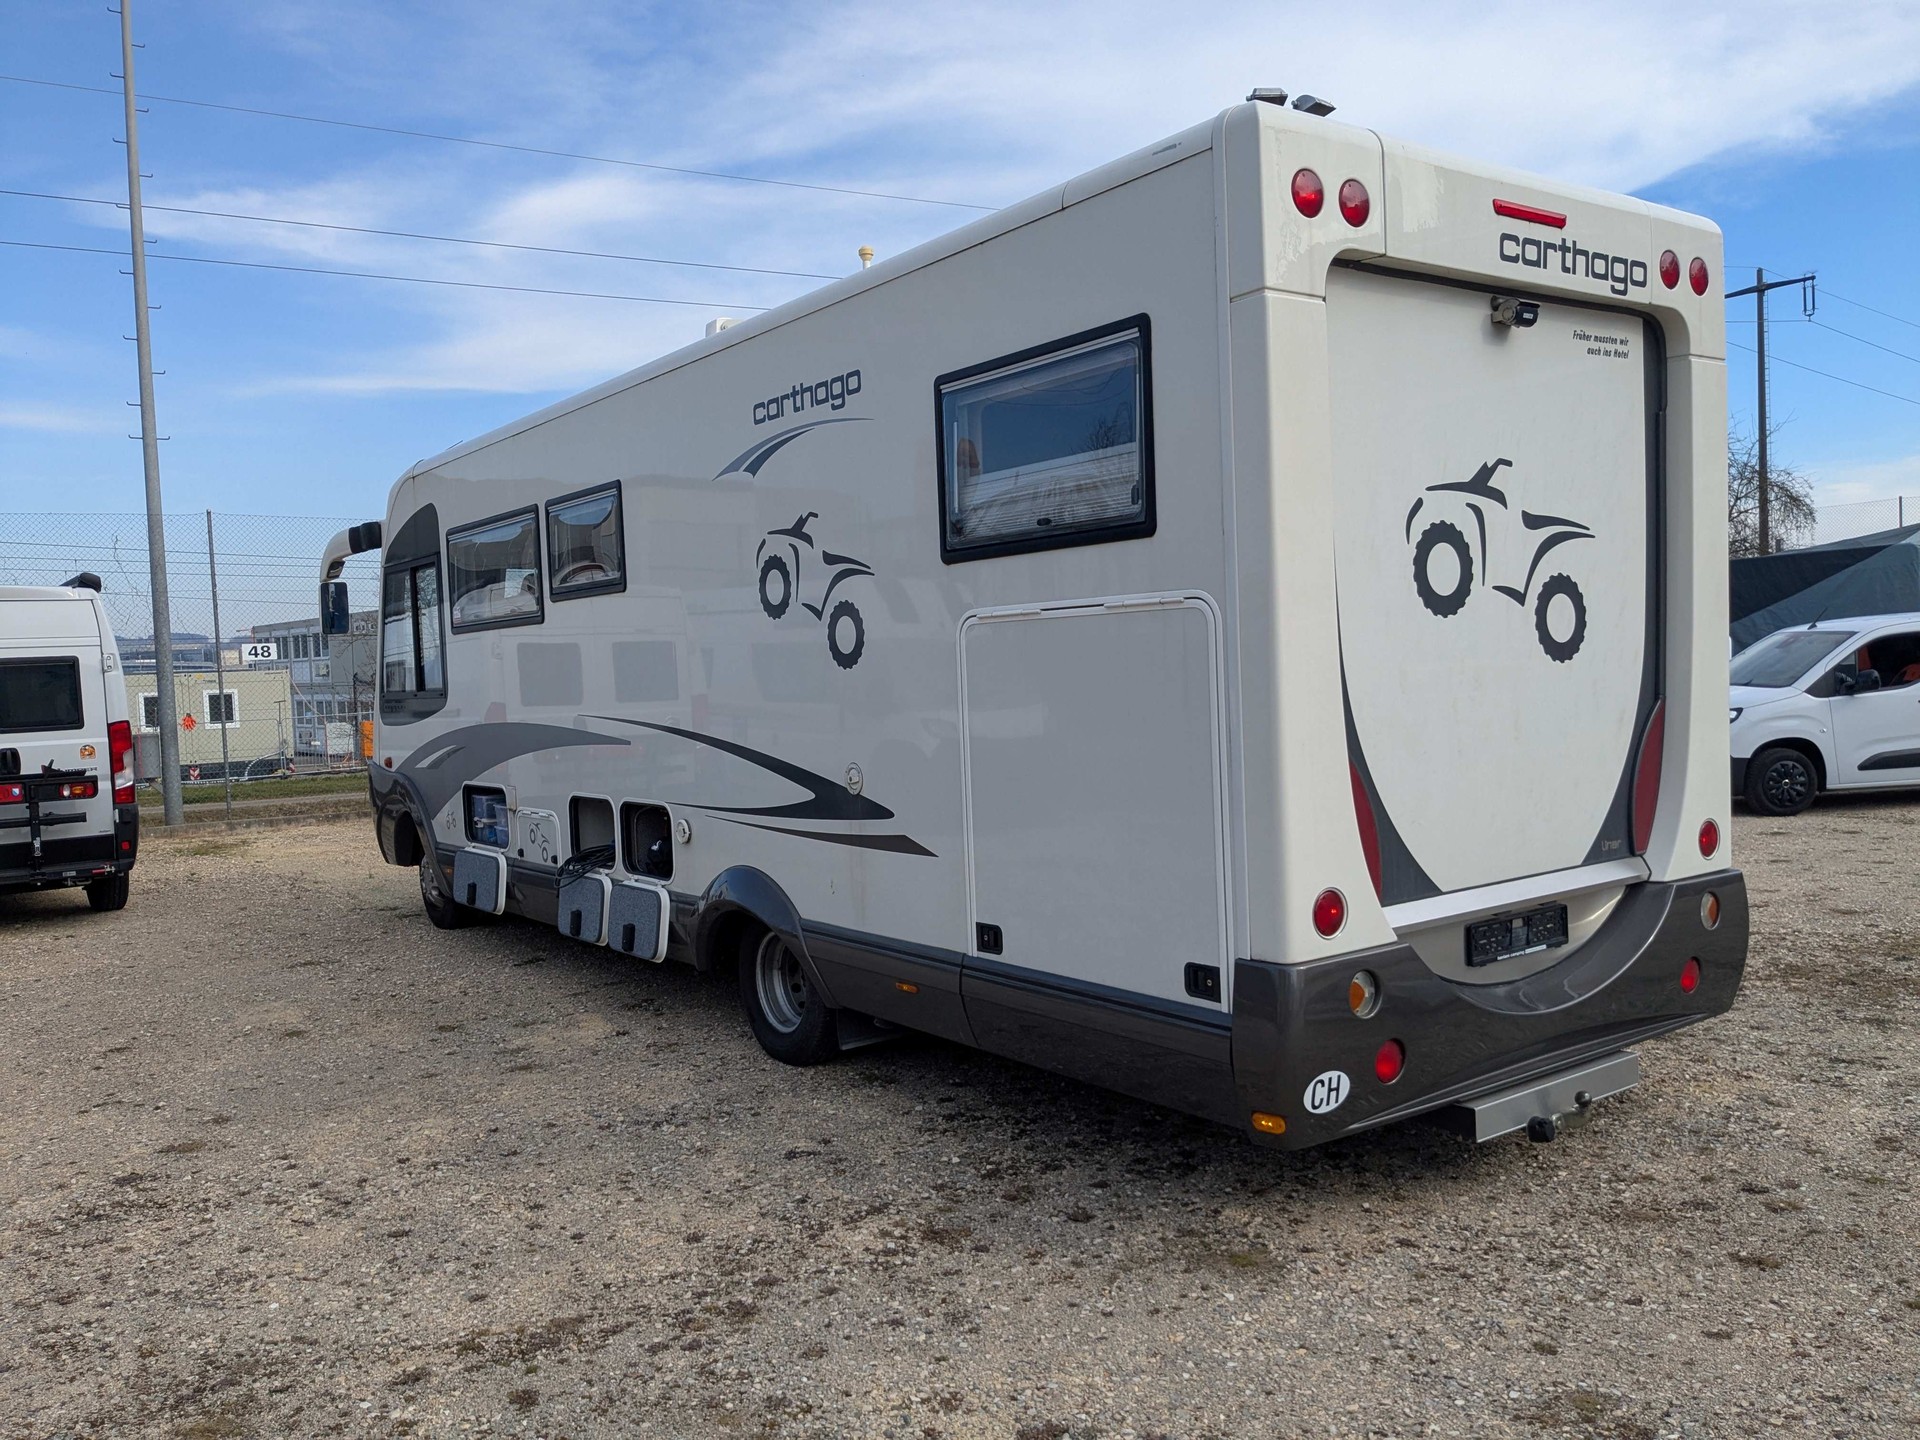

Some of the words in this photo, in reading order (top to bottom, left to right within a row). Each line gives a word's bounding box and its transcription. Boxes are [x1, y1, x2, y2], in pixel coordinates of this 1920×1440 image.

[1500, 232, 1648, 296] carthago
[1587, 346, 1601, 356] auch
[1602, 347, 1612, 357] ins
[1613, 348, 1630, 359] Hotel
[1594, 335, 1618, 345] mussten
[1619, 337, 1629, 346] wir
[753, 369, 862, 425] carthago
[248, 645, 272, 658] 48
[1311, 1074, 1341, 1110] CH
